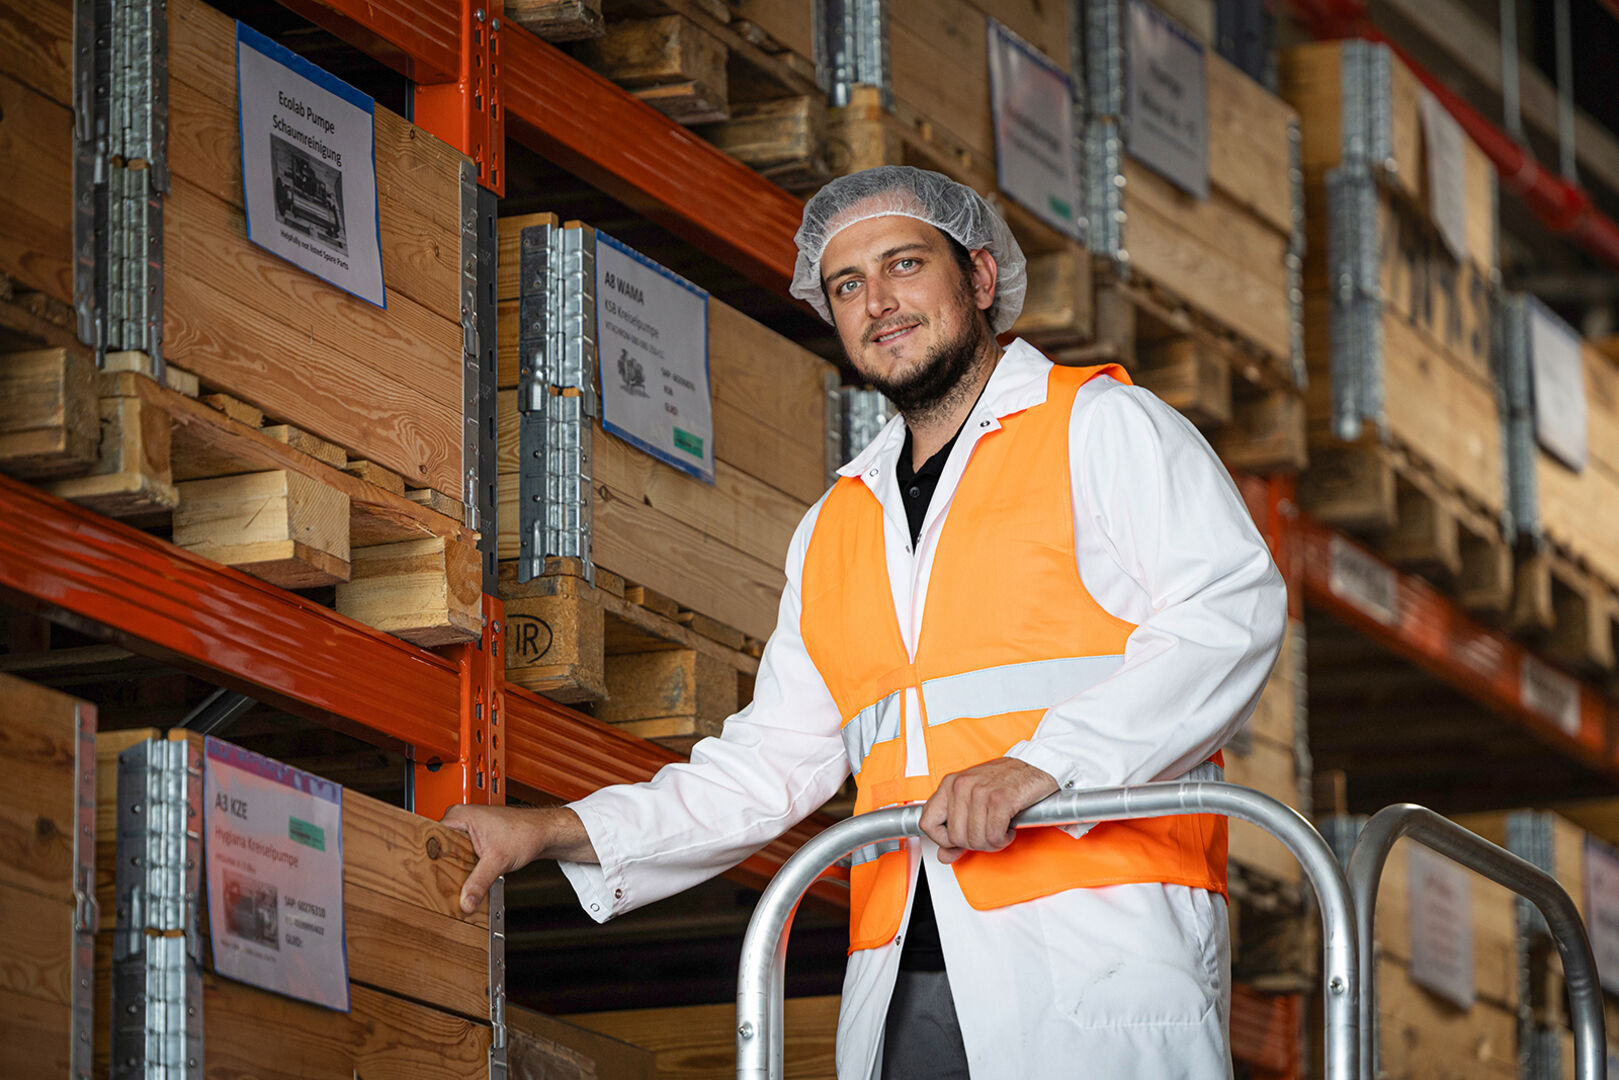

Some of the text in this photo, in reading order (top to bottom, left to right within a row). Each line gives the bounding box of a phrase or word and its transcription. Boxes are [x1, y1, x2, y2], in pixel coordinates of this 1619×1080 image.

[278, 90, 335, 134] Ecolab Pumpe
[272, 114, 342, 167] Schaumreinigung
[604, 271, 645, 306] A8 WAMA
[215, 792, 248, 820] A3 KZE
[247, 836, 299, 868] Kreiselpumpe
